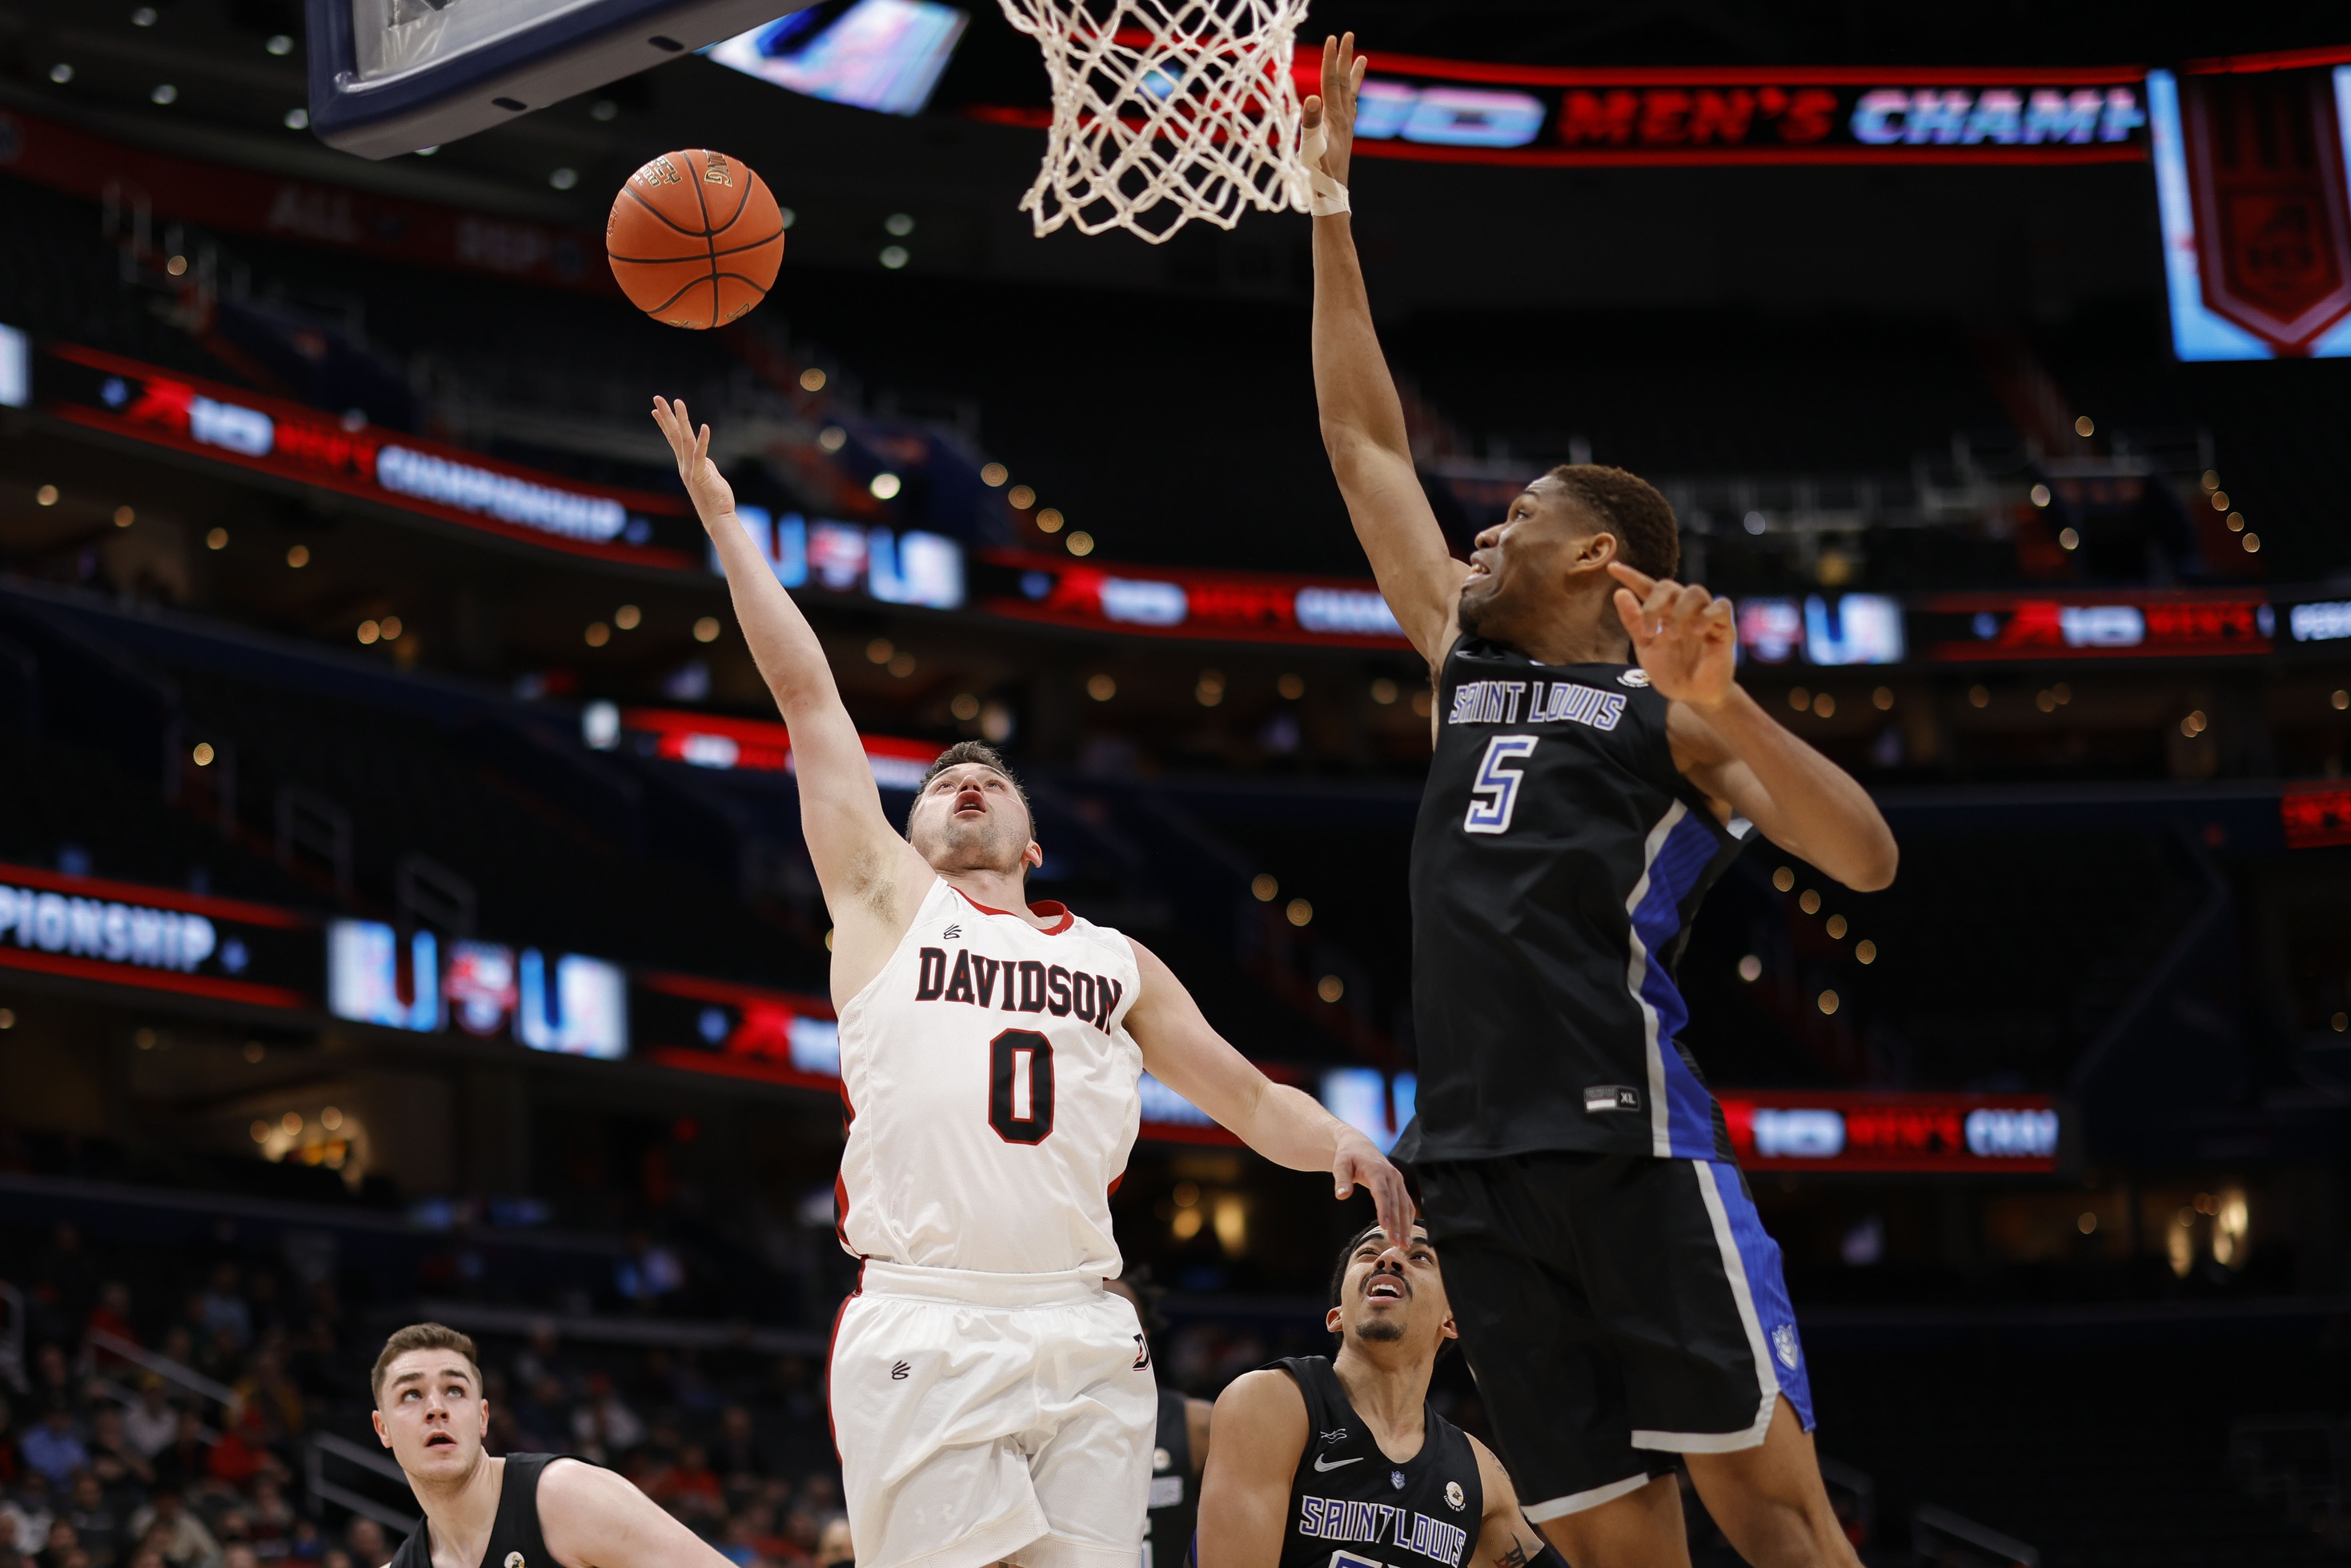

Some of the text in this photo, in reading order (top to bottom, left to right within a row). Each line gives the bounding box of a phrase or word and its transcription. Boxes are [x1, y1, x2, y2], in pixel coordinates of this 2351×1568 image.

[1557, 88, 1837, 145] MEN'S
[376, 444, 628, 544] CHAMPIONSHIP
[1448, 681, 1627, 731] SAINT LOUIS
[1463, 735, 1539, 834] 5
[915, 947, 1122, 1036] DAVIDSON
[988, 1028, 1054, 1146] 0
[1619, 1092, 1638, 1105] XL
[1299, 1495, 1394, 1544] SAINT
[1392, 1507, 1466, 1568] LOUIS
